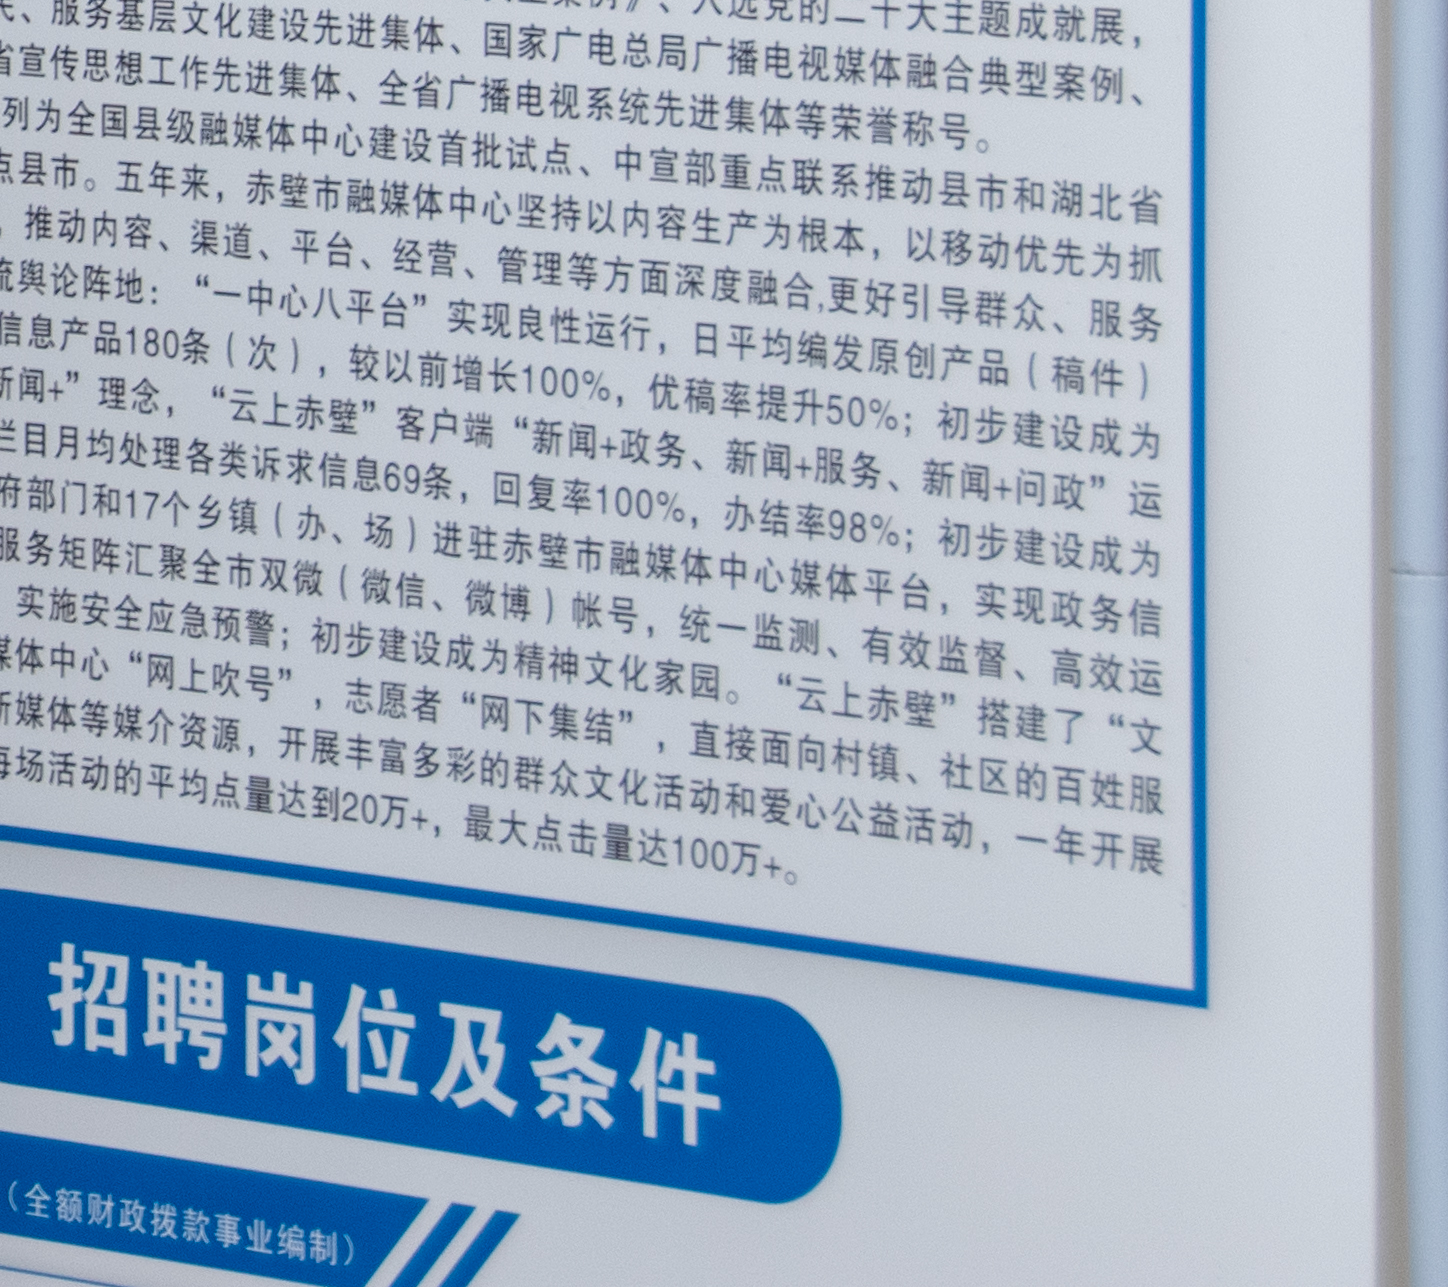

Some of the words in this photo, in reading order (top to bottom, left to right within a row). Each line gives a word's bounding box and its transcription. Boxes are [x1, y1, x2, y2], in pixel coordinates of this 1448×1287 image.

[47, 940, 722, 1149] 招聘岗位及条件
